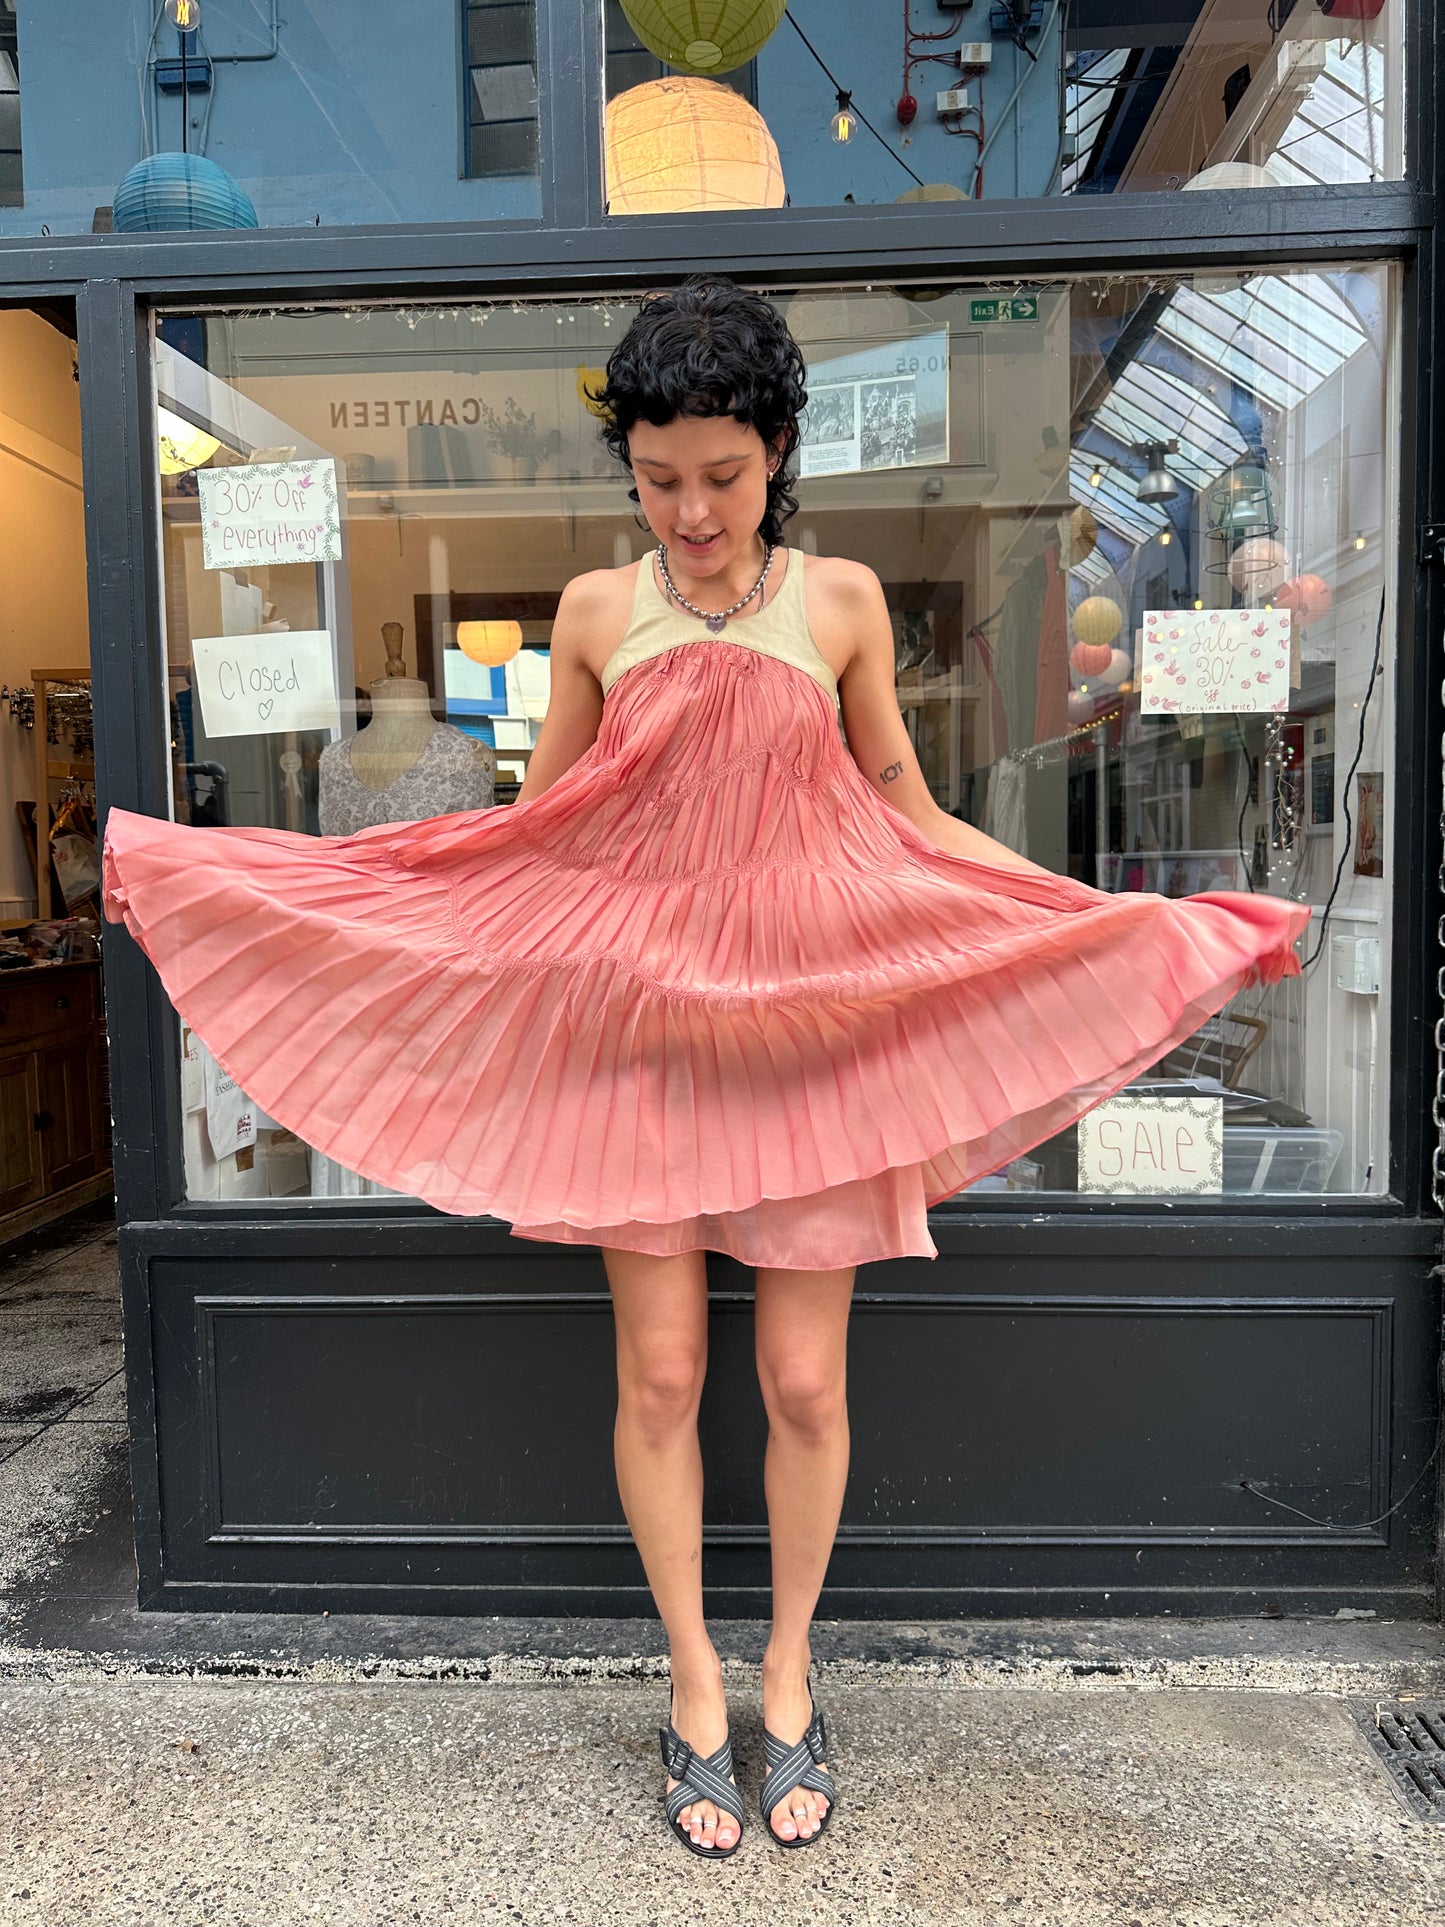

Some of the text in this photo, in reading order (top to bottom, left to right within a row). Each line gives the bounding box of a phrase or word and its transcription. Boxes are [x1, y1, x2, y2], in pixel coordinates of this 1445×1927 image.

[214, 479, 306, 515] 30% Off
[223, 523, 316, 555] everything
[1189, 620, 1248, 654] Sale
[218, 658, 300, 700] Closed
[1196, 656, 1234, 687] 30%
